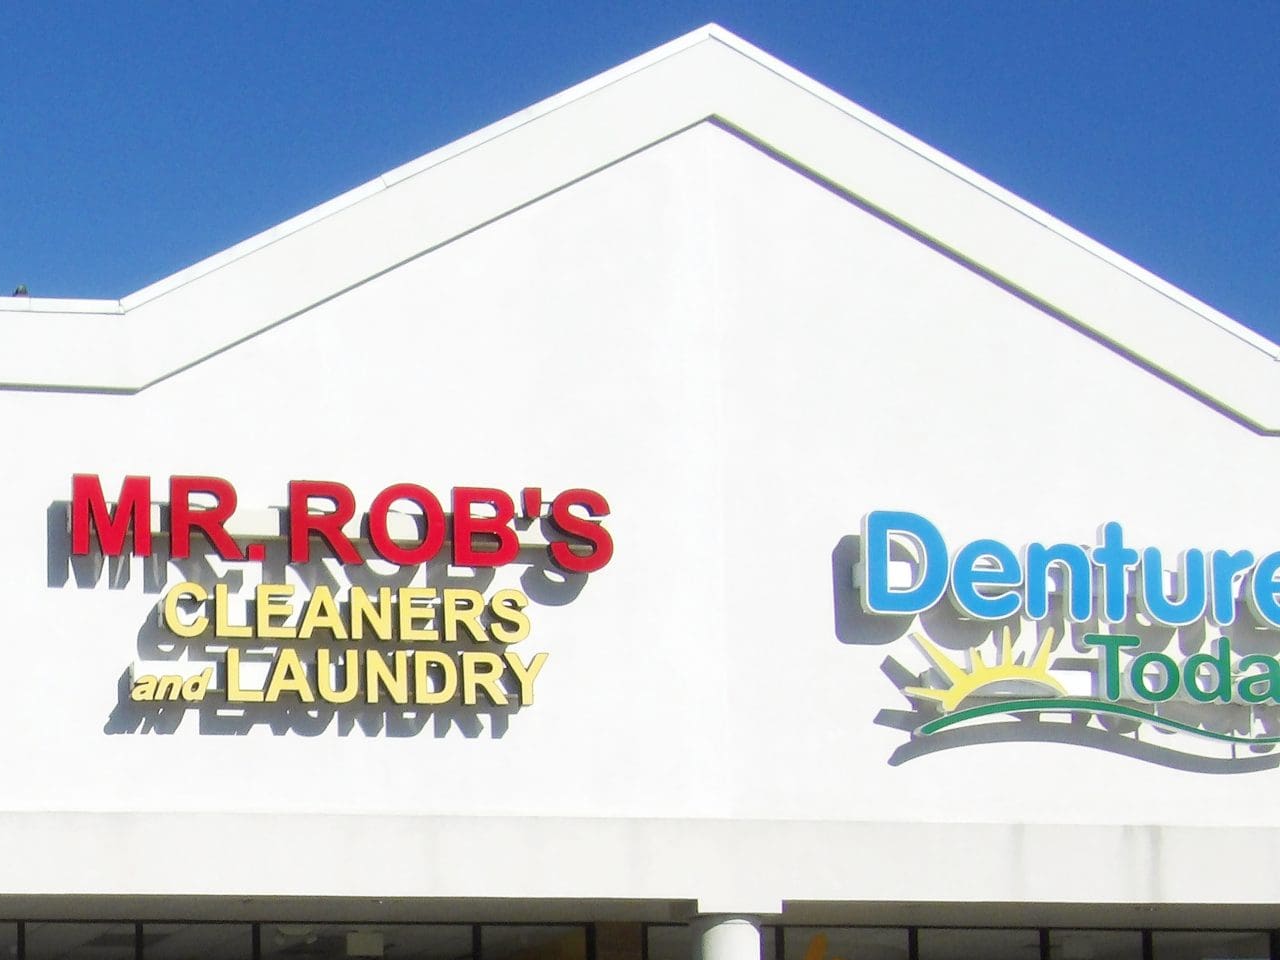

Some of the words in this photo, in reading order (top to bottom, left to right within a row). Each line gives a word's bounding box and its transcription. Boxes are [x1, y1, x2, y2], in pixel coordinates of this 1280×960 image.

[71, 473, 266, 562] MR.
[287, 479, 614, 573] ROB'S
[164, 582, 531, 644] CLEANERS
[131, 667, 212, 701] and
[226, 649, 549, 706] LAUNDRY
[1083, 633, 1280, 705] Toda
